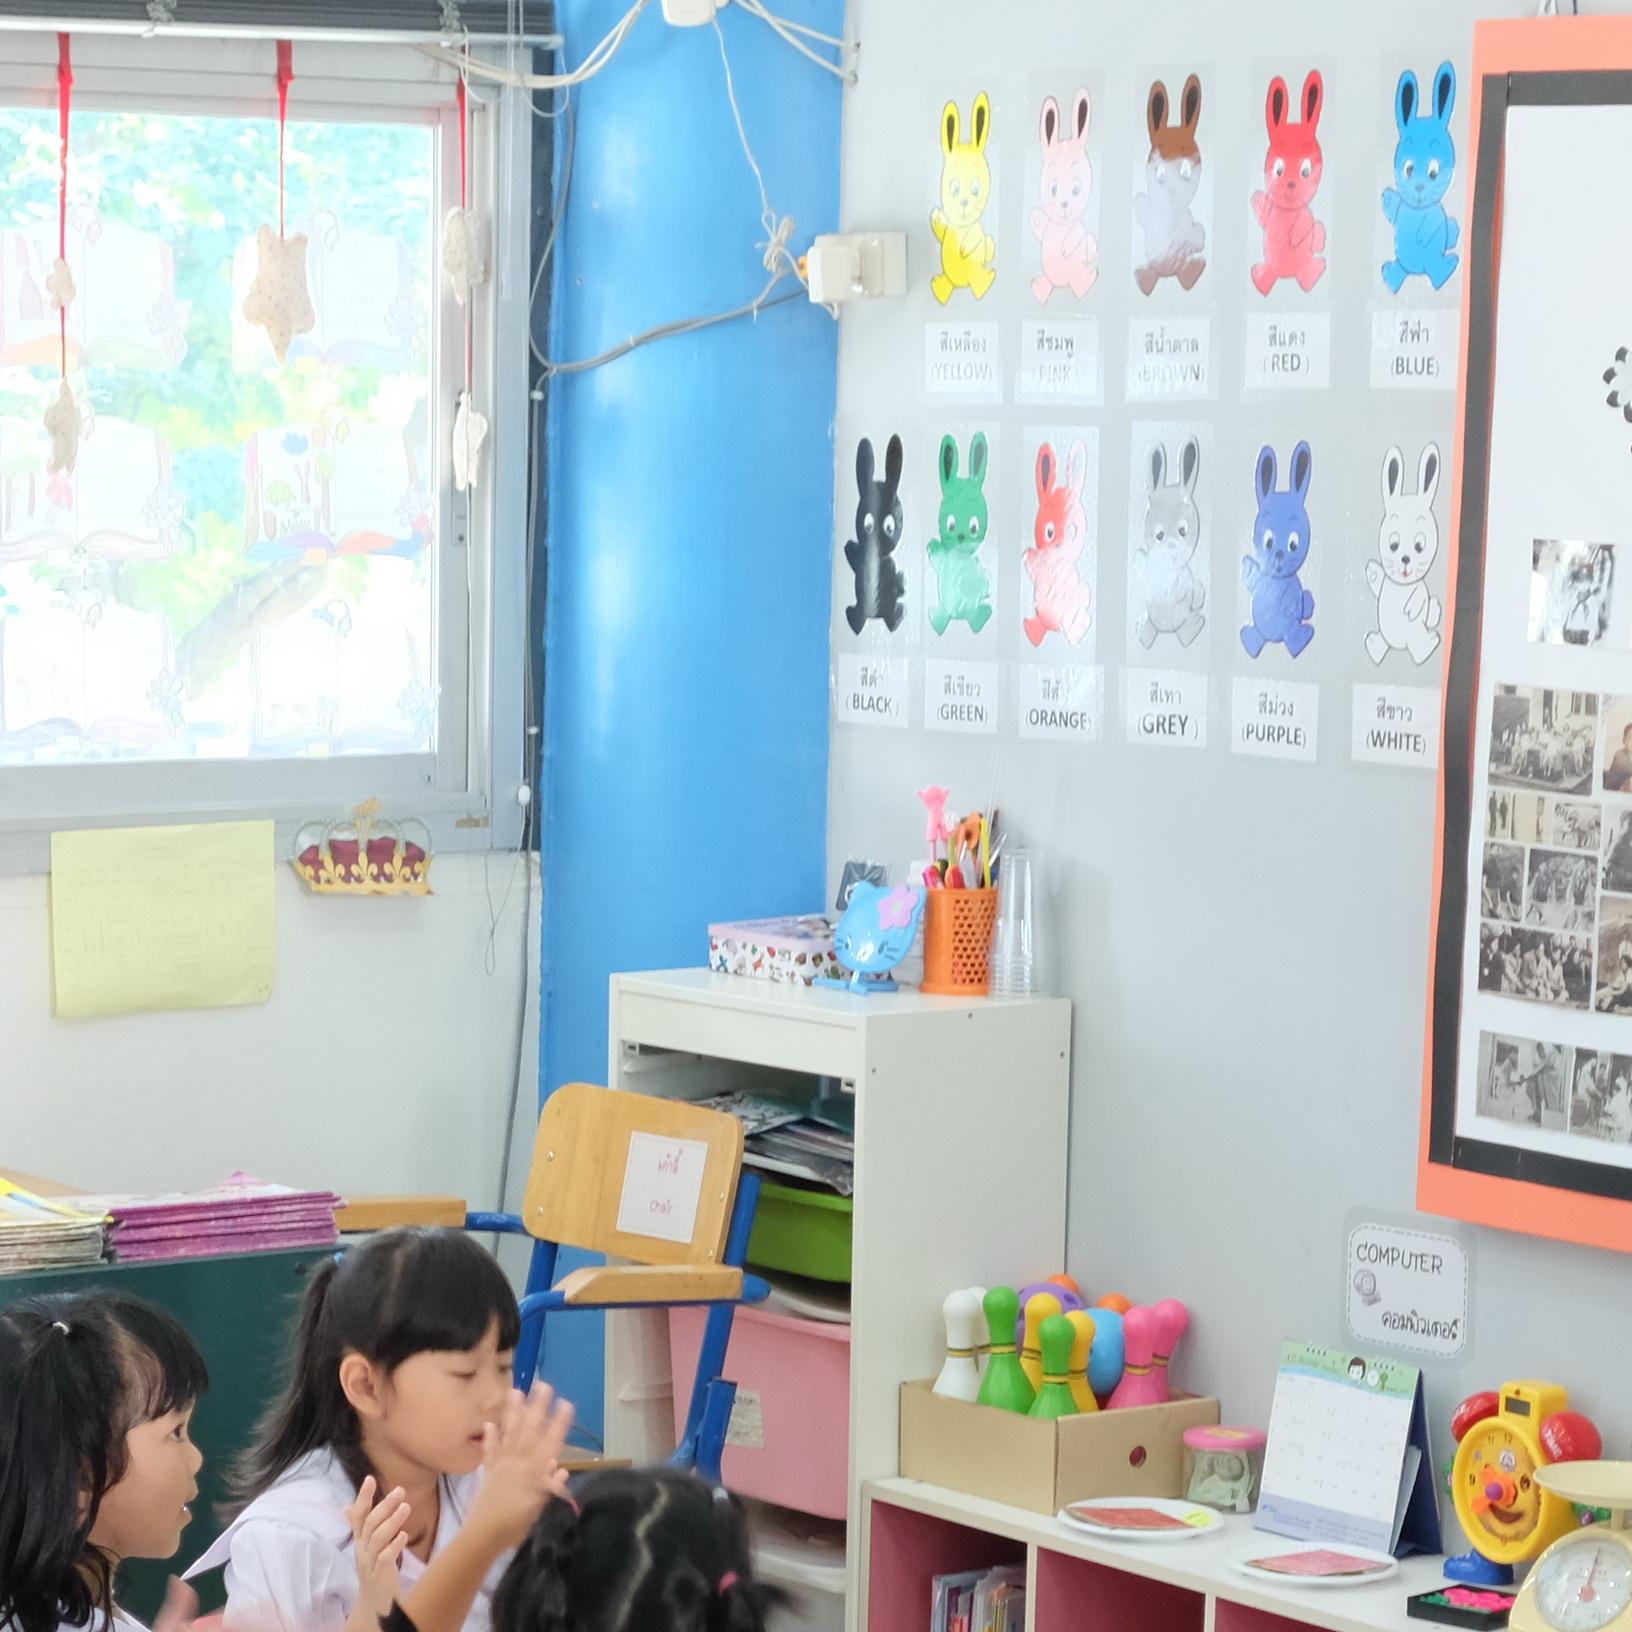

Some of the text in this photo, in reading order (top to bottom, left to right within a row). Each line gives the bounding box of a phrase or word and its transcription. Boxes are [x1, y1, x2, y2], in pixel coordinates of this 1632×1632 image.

[939, 331, 987, 353] สีเหลือง
[1037, 329, 1075, 358] สีชมพู
[1144, 320, 1199, 354] สีน้ำตาล
[1269, 325, 1306, 348] สีแดง
[944, 674, 981, 698] สีเขียว
[1150, 682, 1182, 705] สีเทา
[1258, 692, 1294, 718] สีม่วง
[1376, 696, 1412, 722] สีขาว
[1356, 1241, 1443, 1276] COMPUTER
